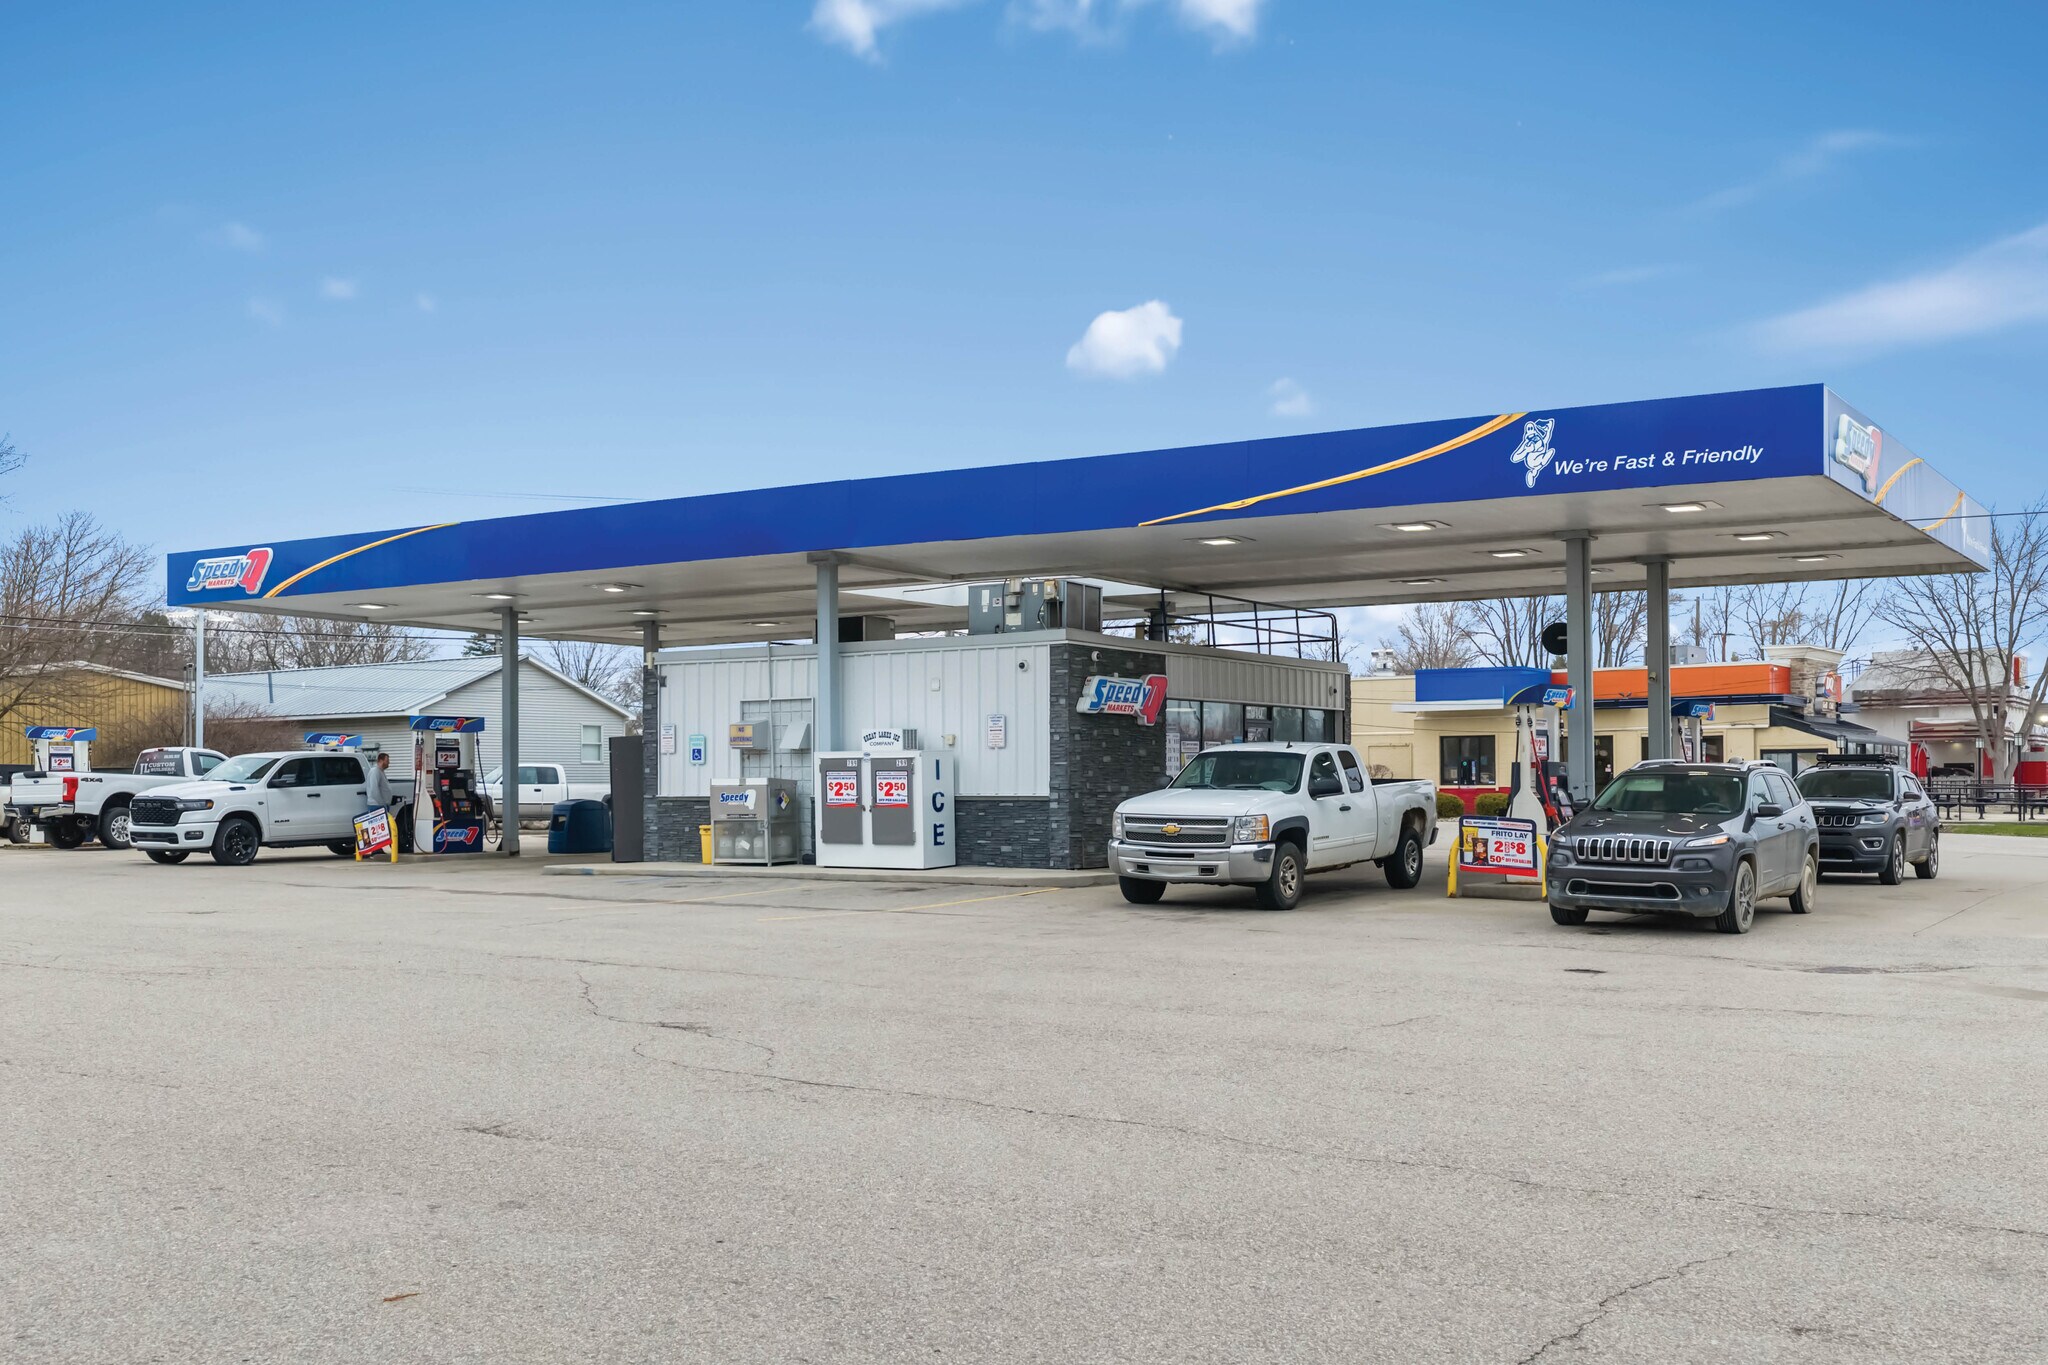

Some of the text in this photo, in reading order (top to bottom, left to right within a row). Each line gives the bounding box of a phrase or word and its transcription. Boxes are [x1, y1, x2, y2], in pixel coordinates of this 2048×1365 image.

[1555, 445, 1763, 475] We're Fast & Friendly
[208, 579, 235, 588] MARKETS
[1106, 704, 1134, 712] MARKETS
[720, 793, 748, 803] Speedy
[931, 759, 945, 846] ICE
[1494, 841, 1503, 853] 2
